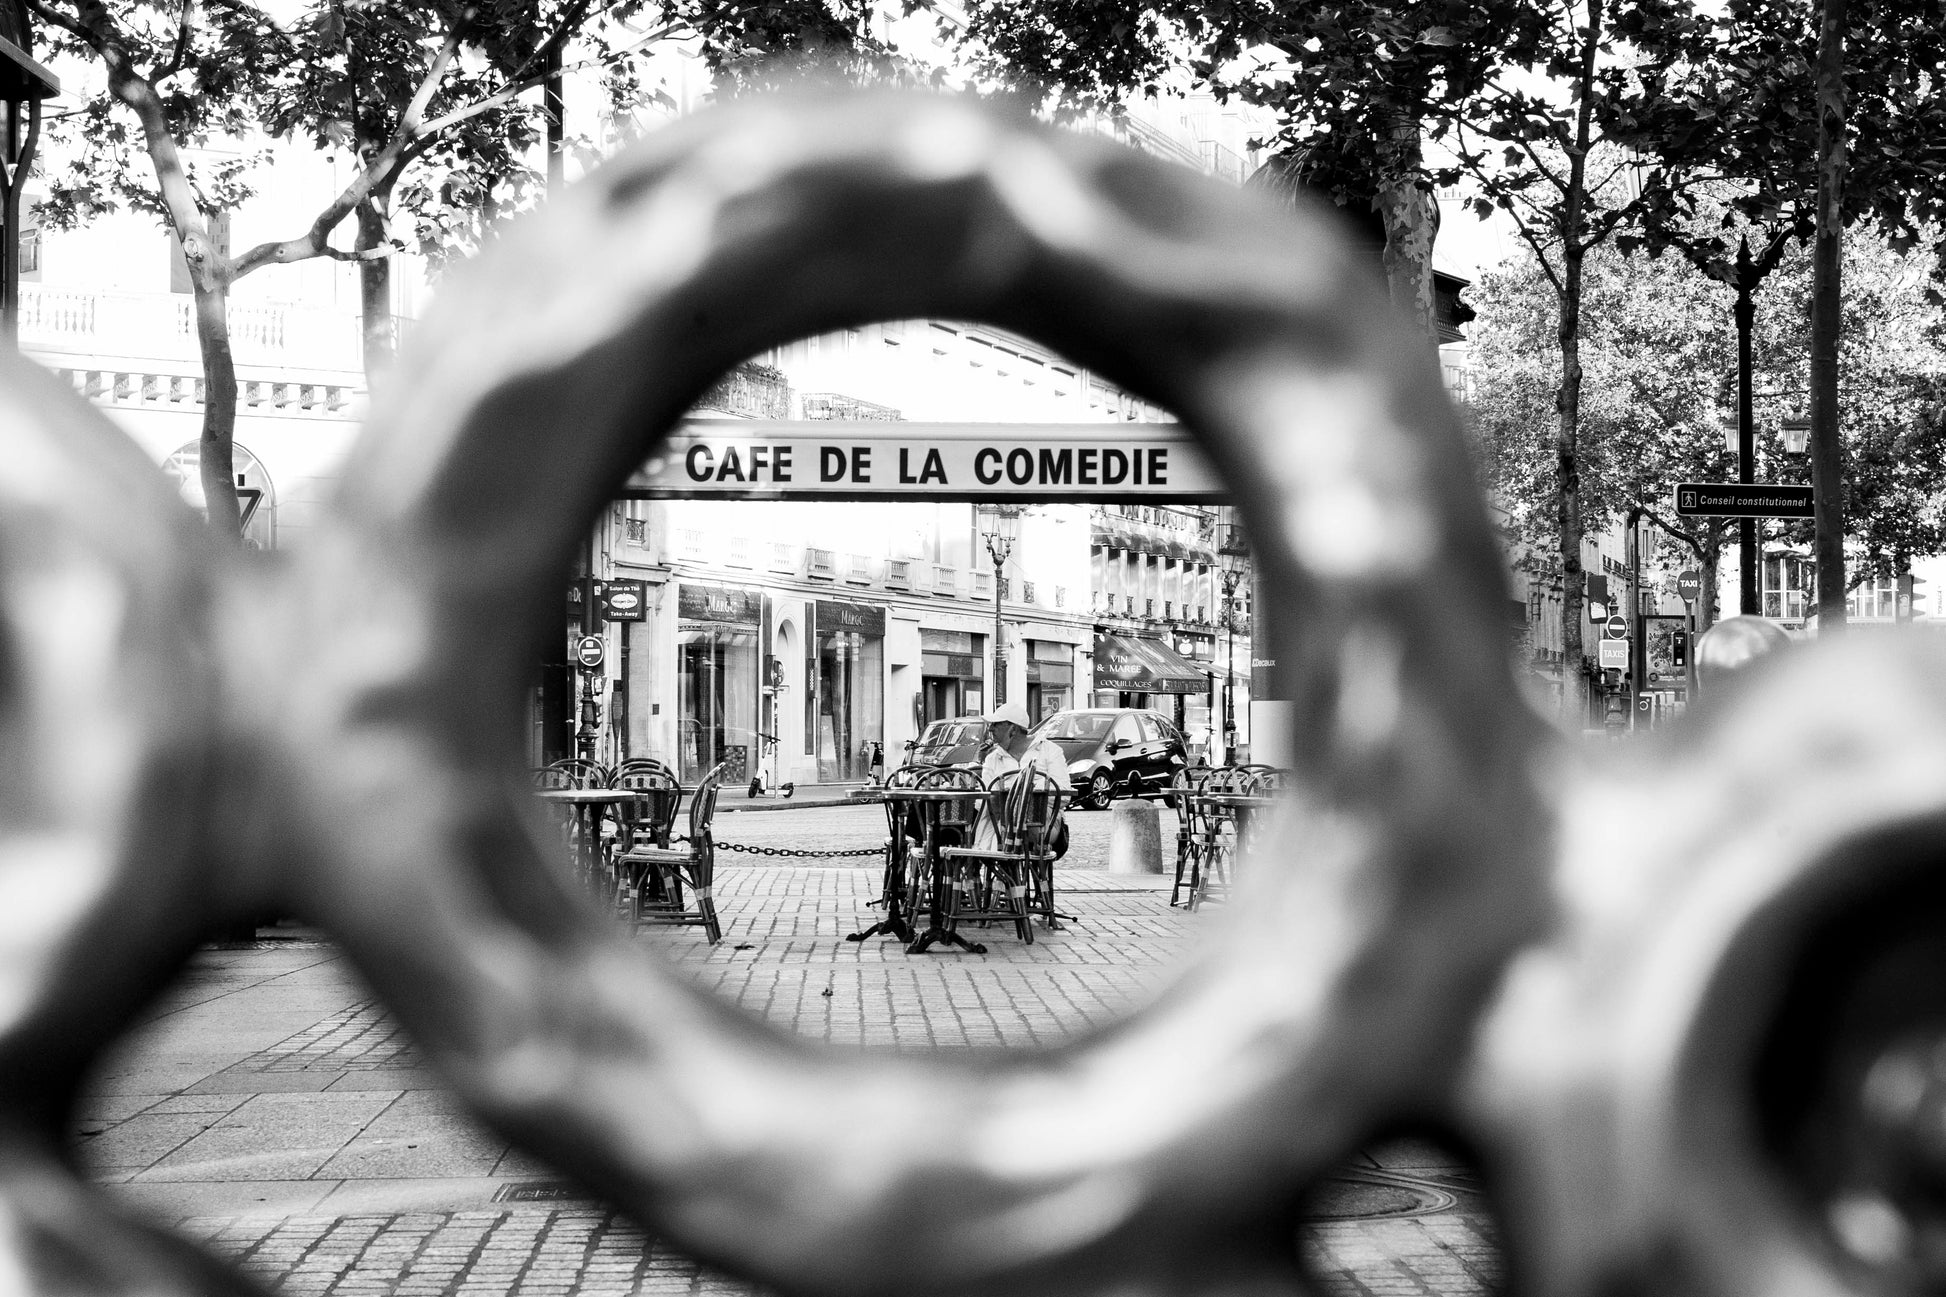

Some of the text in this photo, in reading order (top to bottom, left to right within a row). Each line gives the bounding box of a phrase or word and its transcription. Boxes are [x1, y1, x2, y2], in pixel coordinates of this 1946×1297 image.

[685, 444, 1168, 486] CAFE DE LA COMEDIE
[1700, 495, 1807, 507] Conseil constitutionnel
[1680, 580, 1698, 588] TAXI
[1604, 649, 1625, 658] TAXIS
[1110, 655, 1128, 663] VIN
[1096, 663, 1105, 672] &
[1100, 679, 1152, 688] COQUILLAGES
